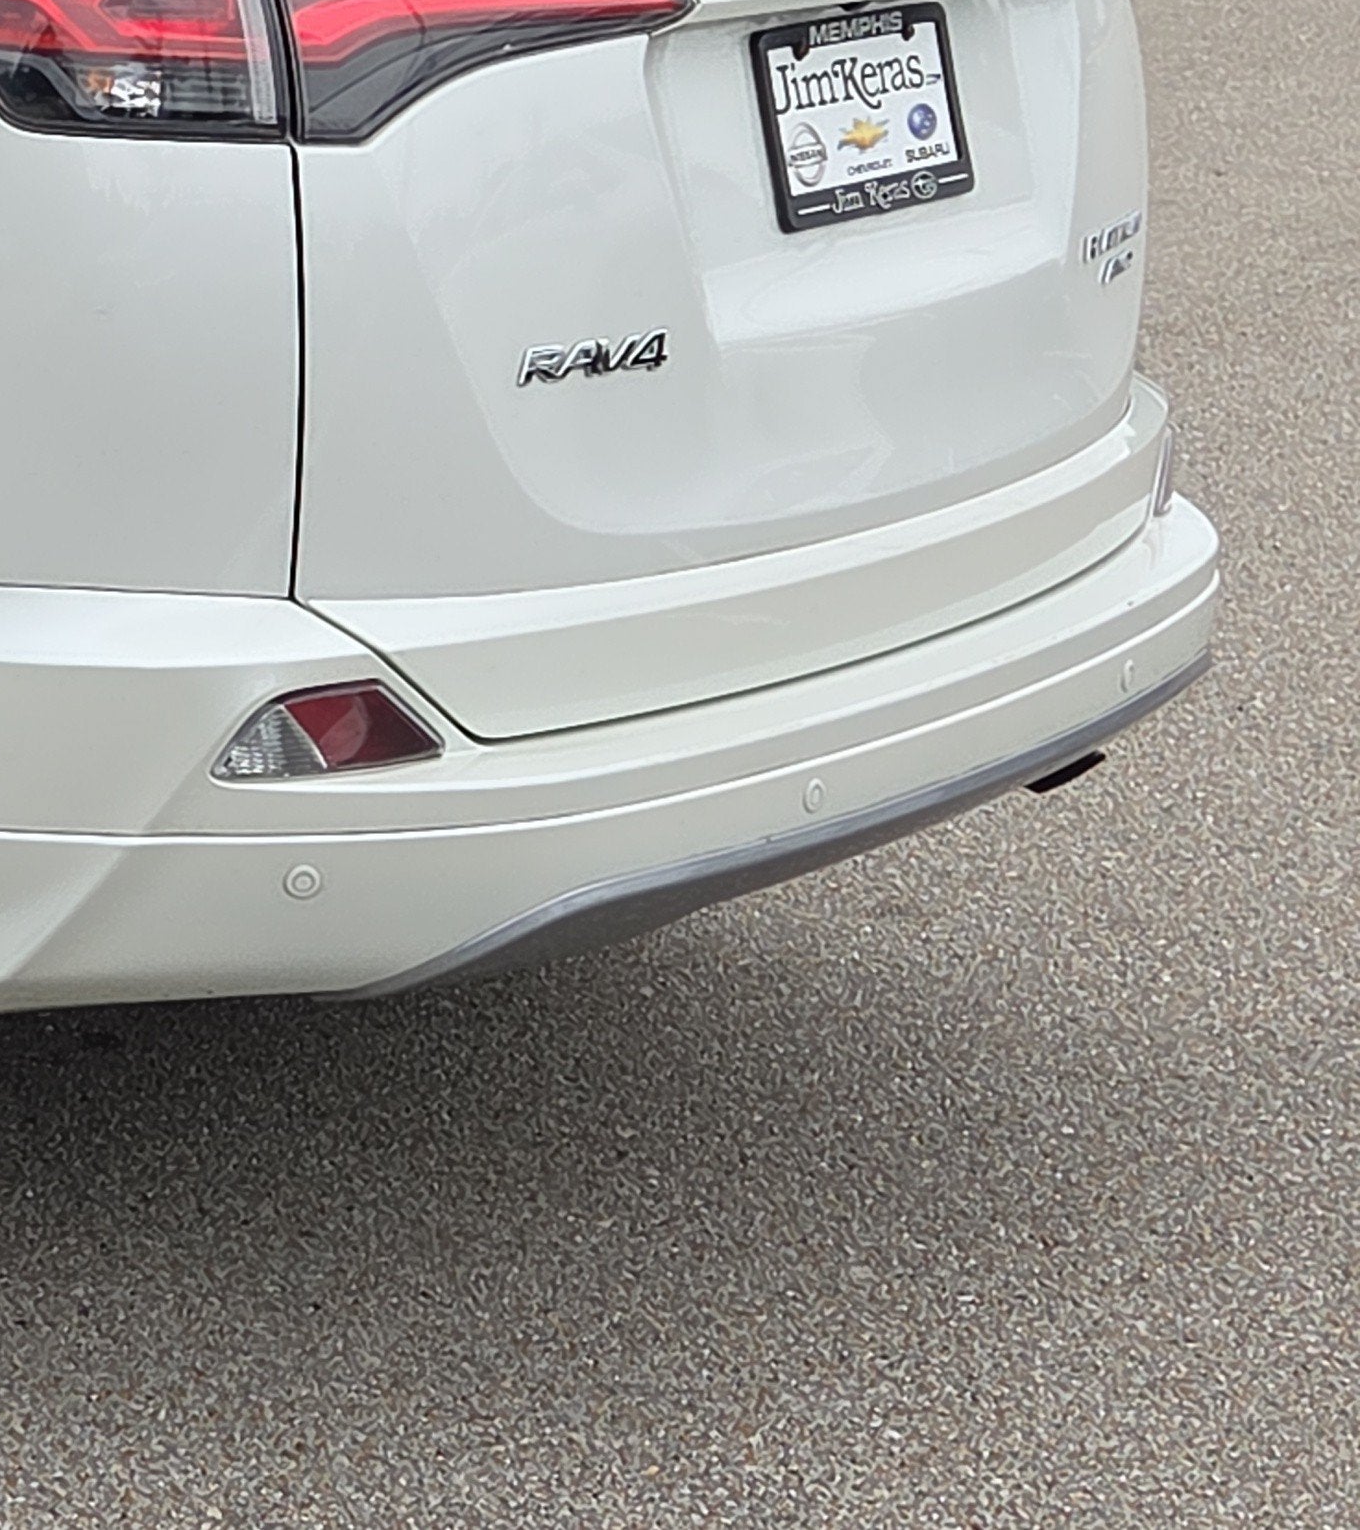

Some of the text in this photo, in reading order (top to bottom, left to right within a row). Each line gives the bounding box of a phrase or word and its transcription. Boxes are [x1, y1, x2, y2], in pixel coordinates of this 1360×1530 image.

[808, 11, 903, 45] MEMPHIS
[905, 142, 950, 163] SUBARU
[832, 188, 865, 213] Jim
[517, 327, 668, 387] RAV4
